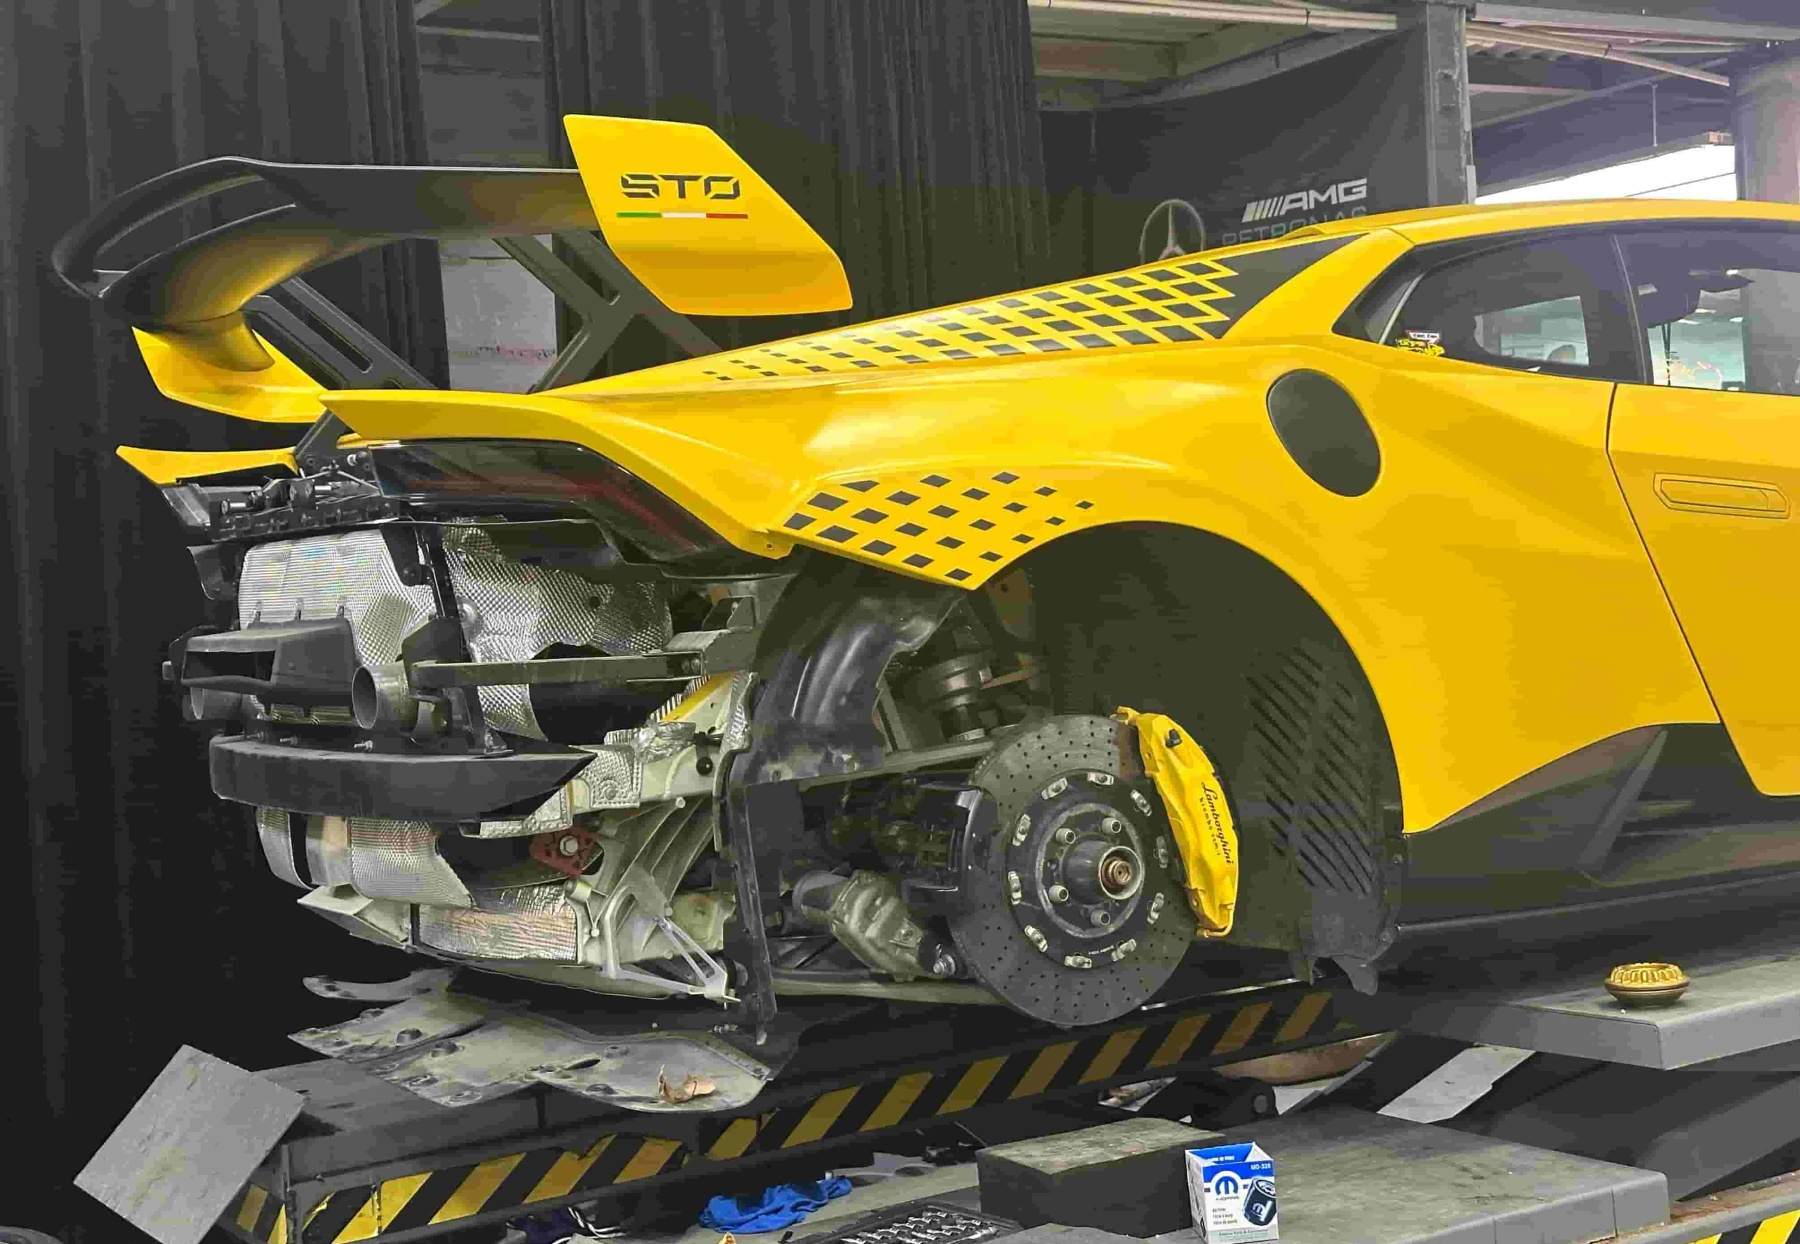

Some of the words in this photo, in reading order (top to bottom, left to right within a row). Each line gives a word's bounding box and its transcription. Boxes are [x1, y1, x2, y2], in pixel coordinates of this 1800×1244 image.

[620, 173, 740, 200] STO
[1280, 177, 1368, 212] AMG
[1201, 781, 1234, 865] Lamborghini
